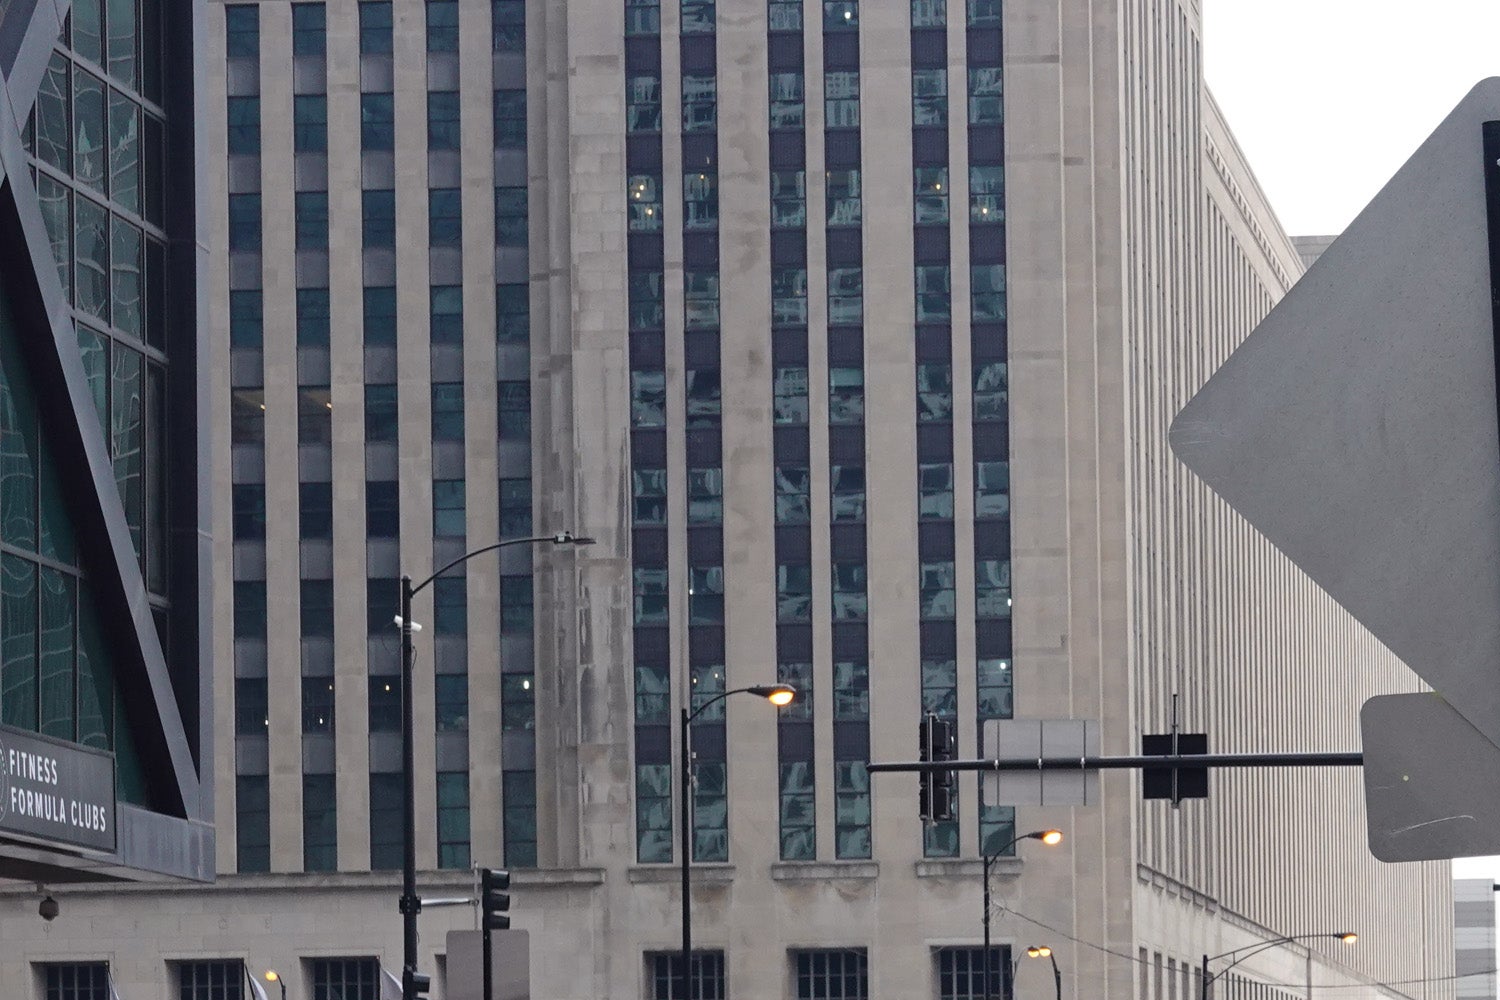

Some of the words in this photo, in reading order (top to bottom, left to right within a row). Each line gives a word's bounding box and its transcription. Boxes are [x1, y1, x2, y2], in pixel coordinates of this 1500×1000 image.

[9, 749, 58, 785] FITNESS
[11, 786, 67, 825] FORMULA
[71, 800, 107, 832] CLUBS
